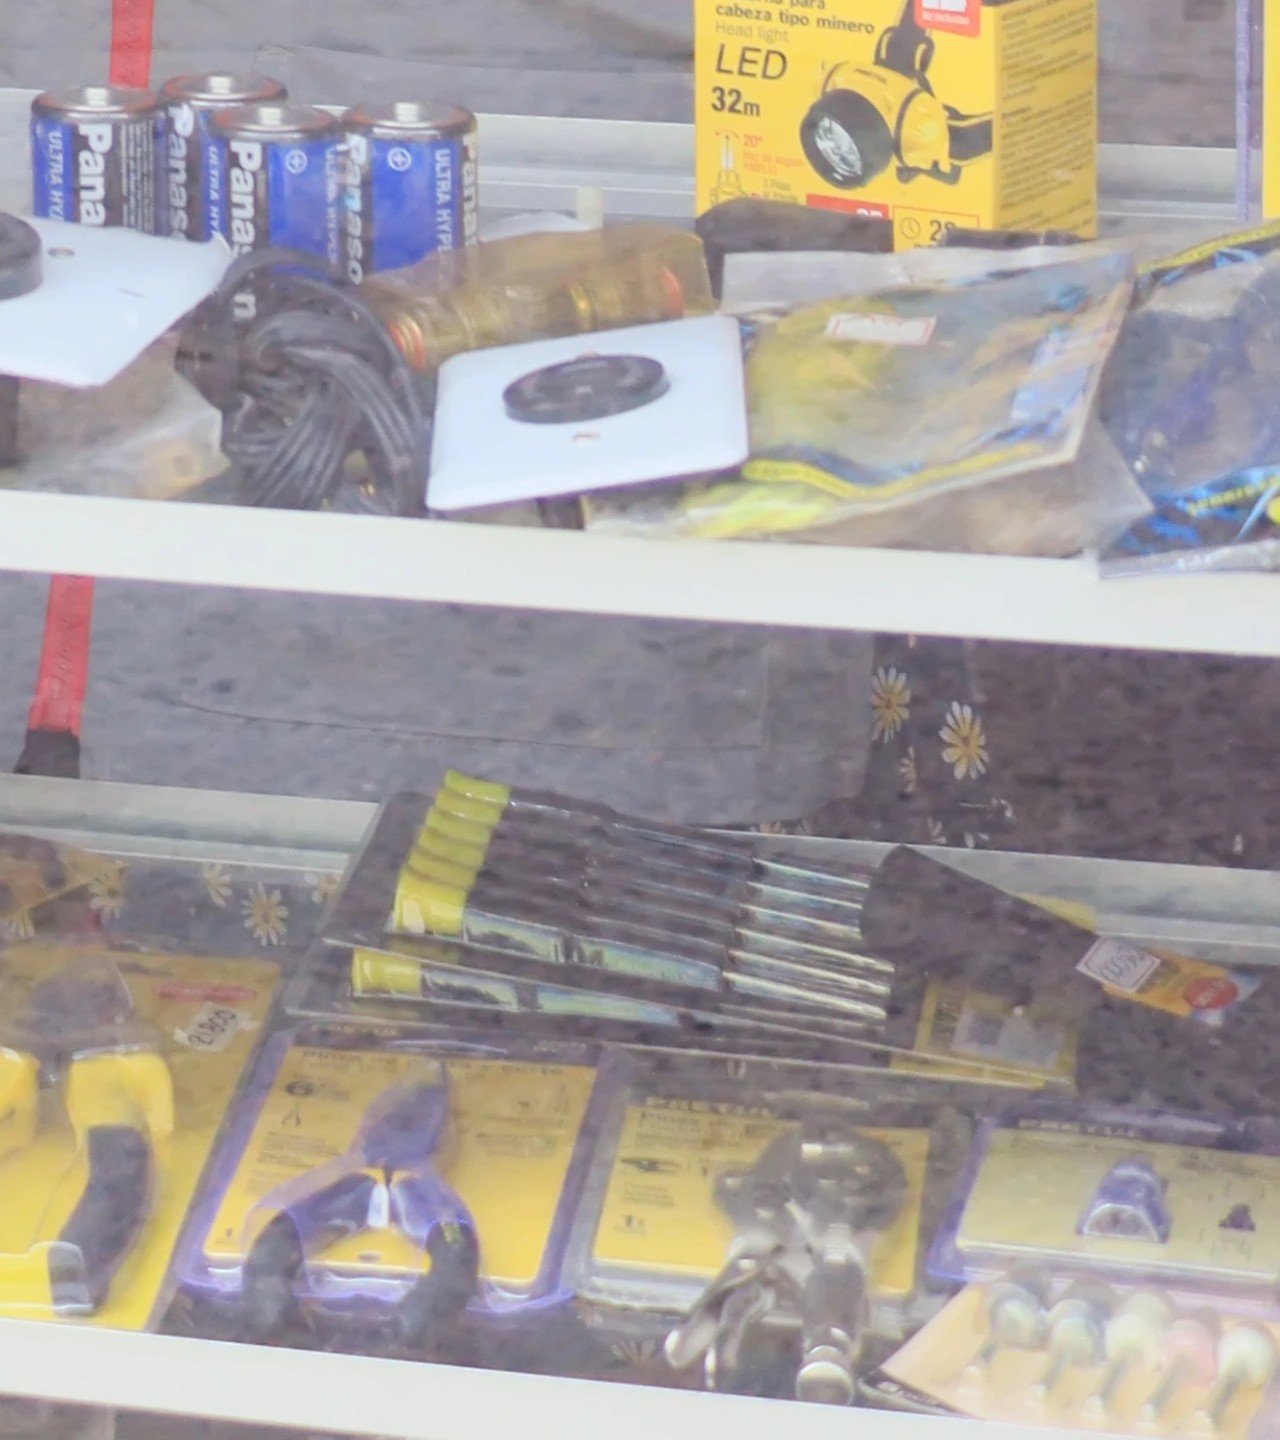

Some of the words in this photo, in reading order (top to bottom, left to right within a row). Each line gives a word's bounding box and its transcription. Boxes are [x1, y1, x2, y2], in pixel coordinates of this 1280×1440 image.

[715, 1, 774, 24] cabeza
[779, 6, 810, 29] tipo
[816, 14, 876, 34] minero
[715, 20, 750, 40] Head
[756, 22, 791, 44] light
[715, 42, 788, 82] LED
[710, 86, 761, 118] 32m
[47, 130, 64, 184] ULTRA
[434, 148, 453, 205] ULTRA
